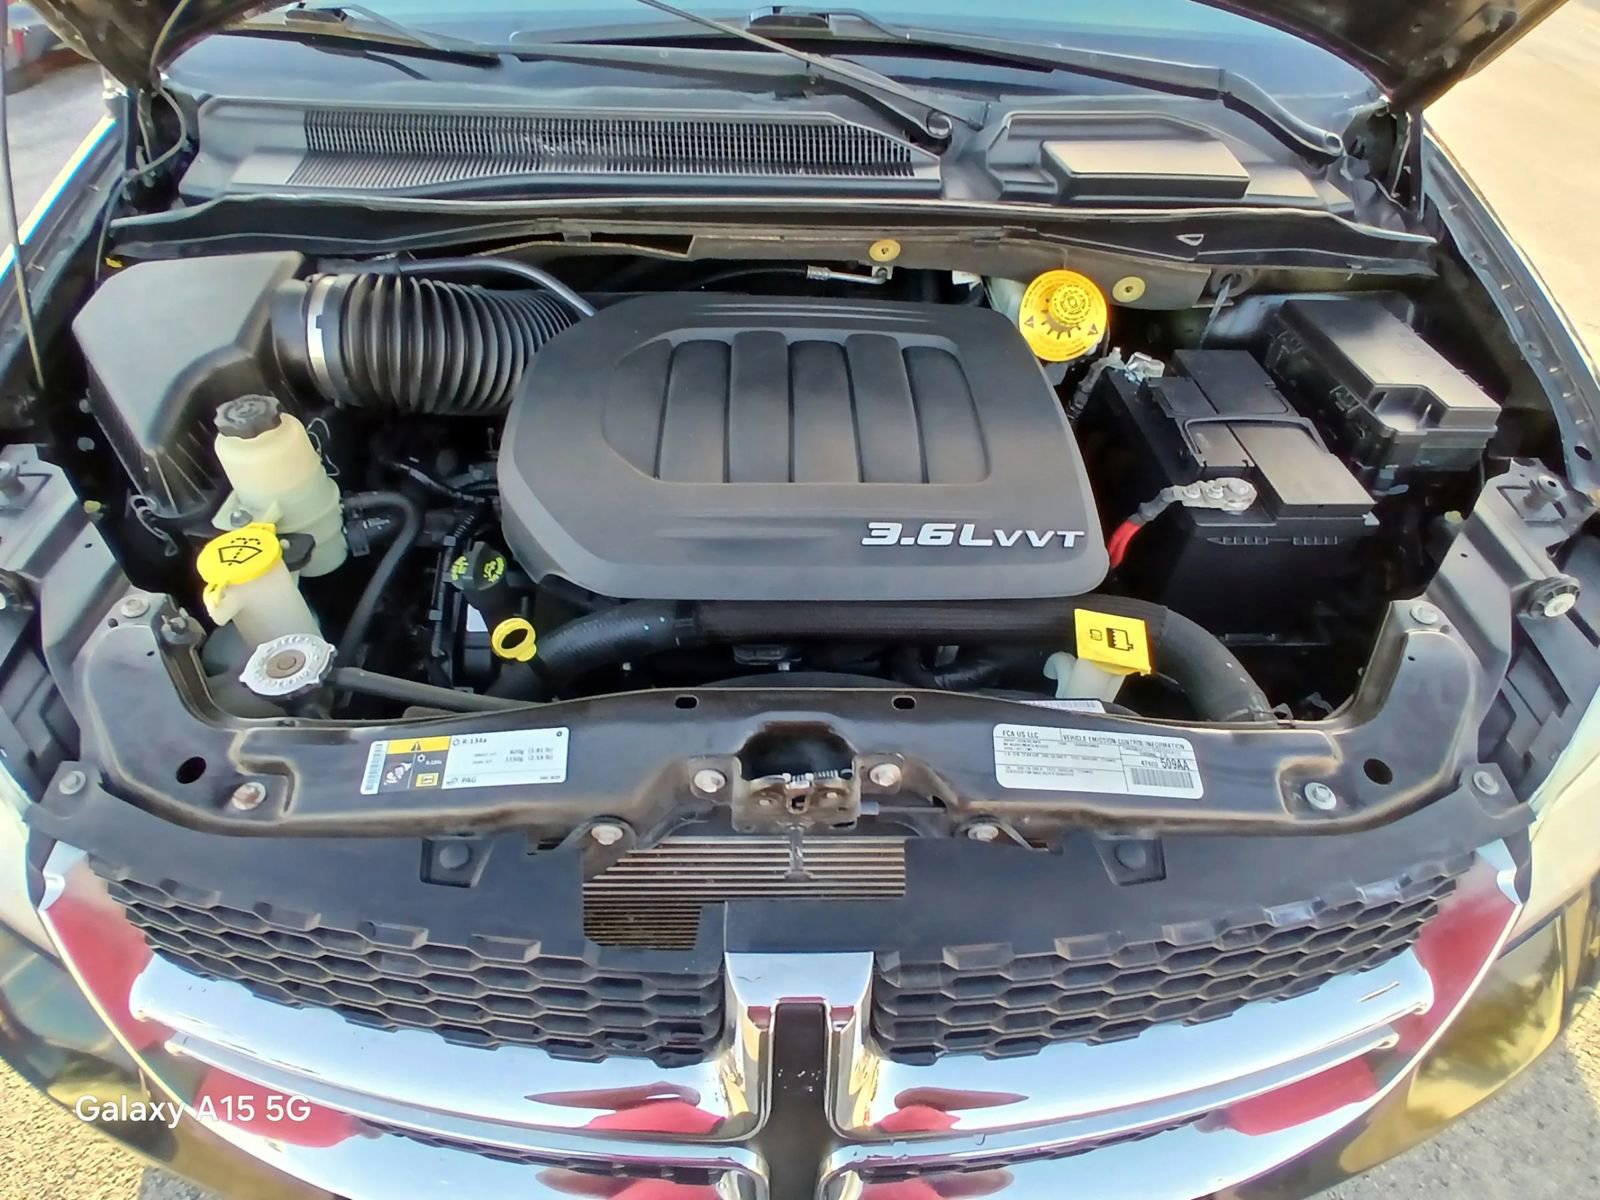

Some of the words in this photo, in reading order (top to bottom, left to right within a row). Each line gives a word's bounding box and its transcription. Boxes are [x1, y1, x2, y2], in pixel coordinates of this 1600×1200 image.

[862, 522, 993, 547] 3.6L
[993, 530, 1086, 548] VVT
[1063, 734, 1087, 742] VEHICLE
[1088, 735, 1117, 744] EMISSION
[1118, 738, 1144, 747] CONTROL
[1145, 740, 1185, 750] INFORMATION
[1160, 757, 1190, 770] 509AA
